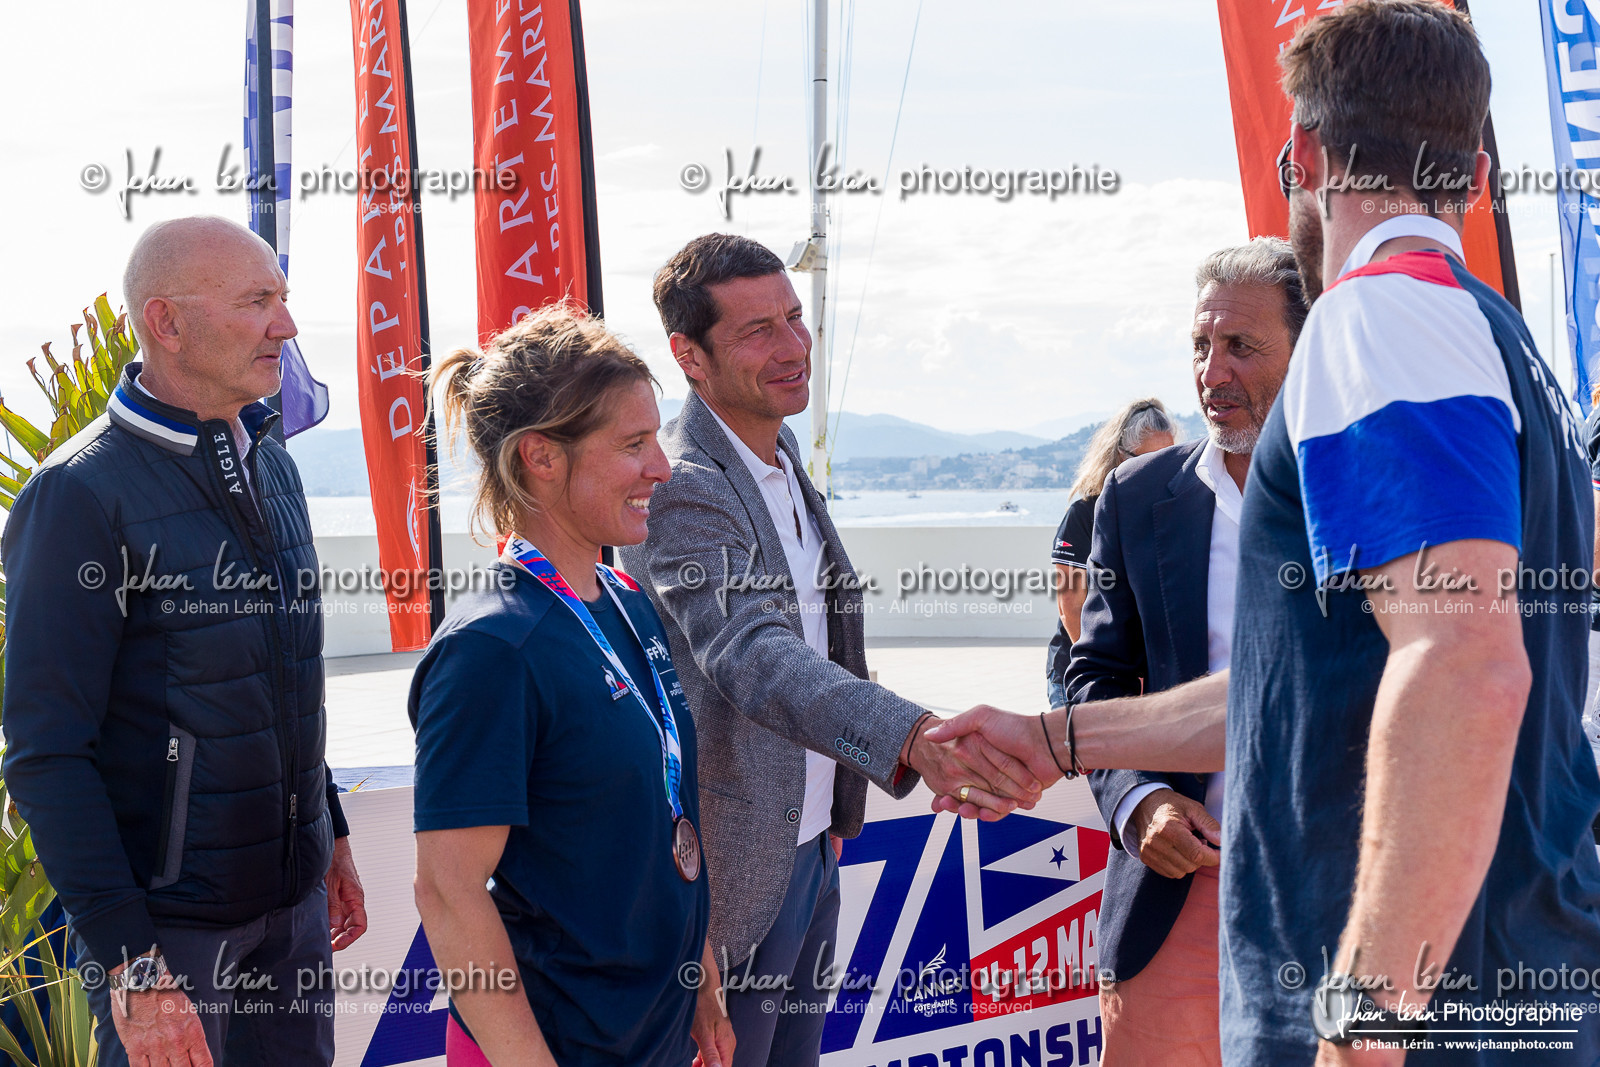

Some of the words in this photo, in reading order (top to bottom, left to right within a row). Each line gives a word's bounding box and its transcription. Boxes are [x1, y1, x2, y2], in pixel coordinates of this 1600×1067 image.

[214, 432, 242, 494] AIGLE
[1057, 908, 1100, 989] MA
[904, 978, 963, 1002] CANNES
